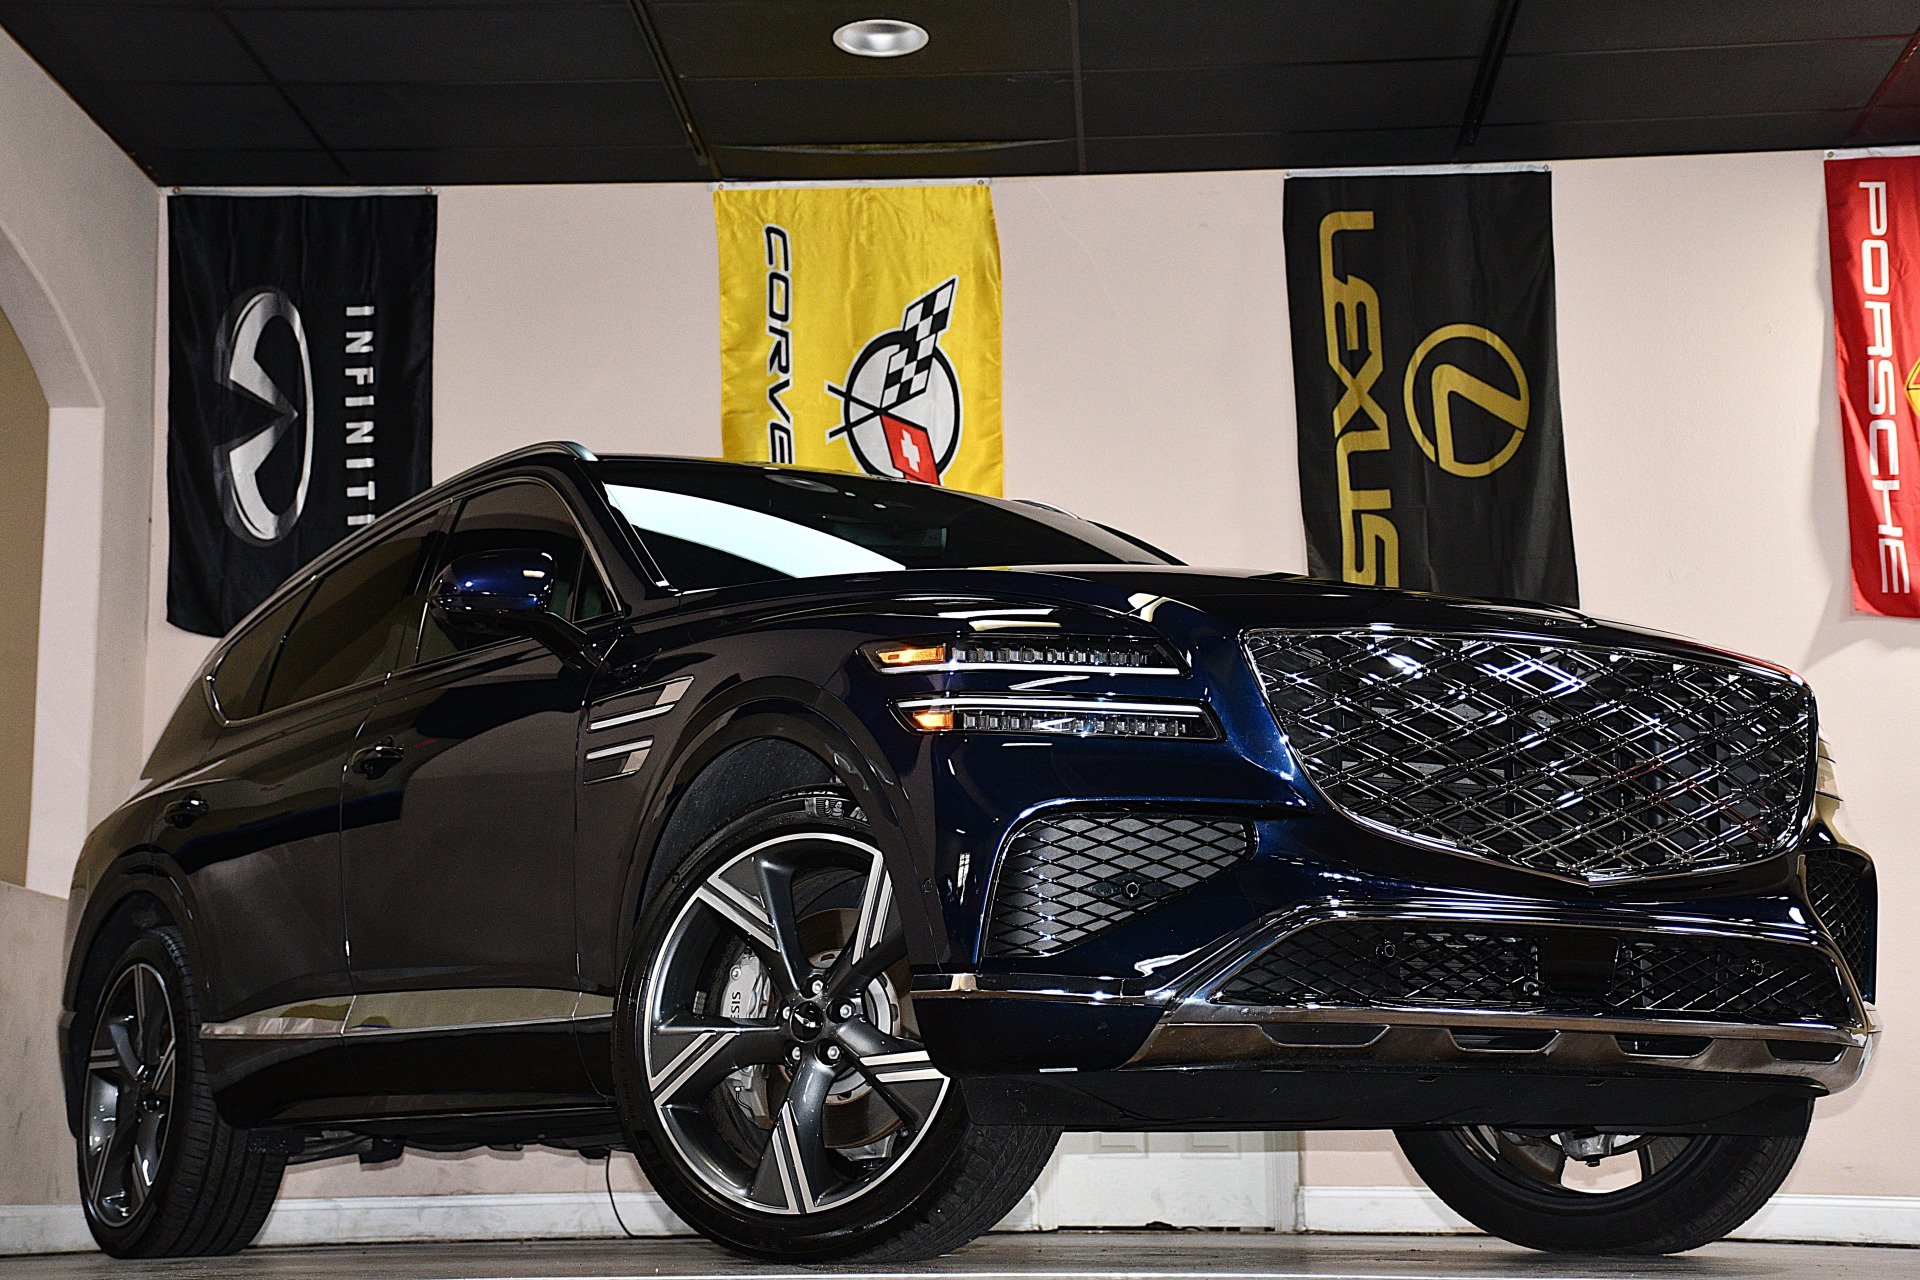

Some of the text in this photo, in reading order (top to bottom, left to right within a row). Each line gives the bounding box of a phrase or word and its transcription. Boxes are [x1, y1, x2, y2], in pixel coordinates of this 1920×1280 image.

[345, 305, 375, 526] INFINITI
[763, 224, 793, 464] CORVE
[1319, 210, 1399, 588] LEXUS
[1859, 181, 1910, 594] PORSCHE
